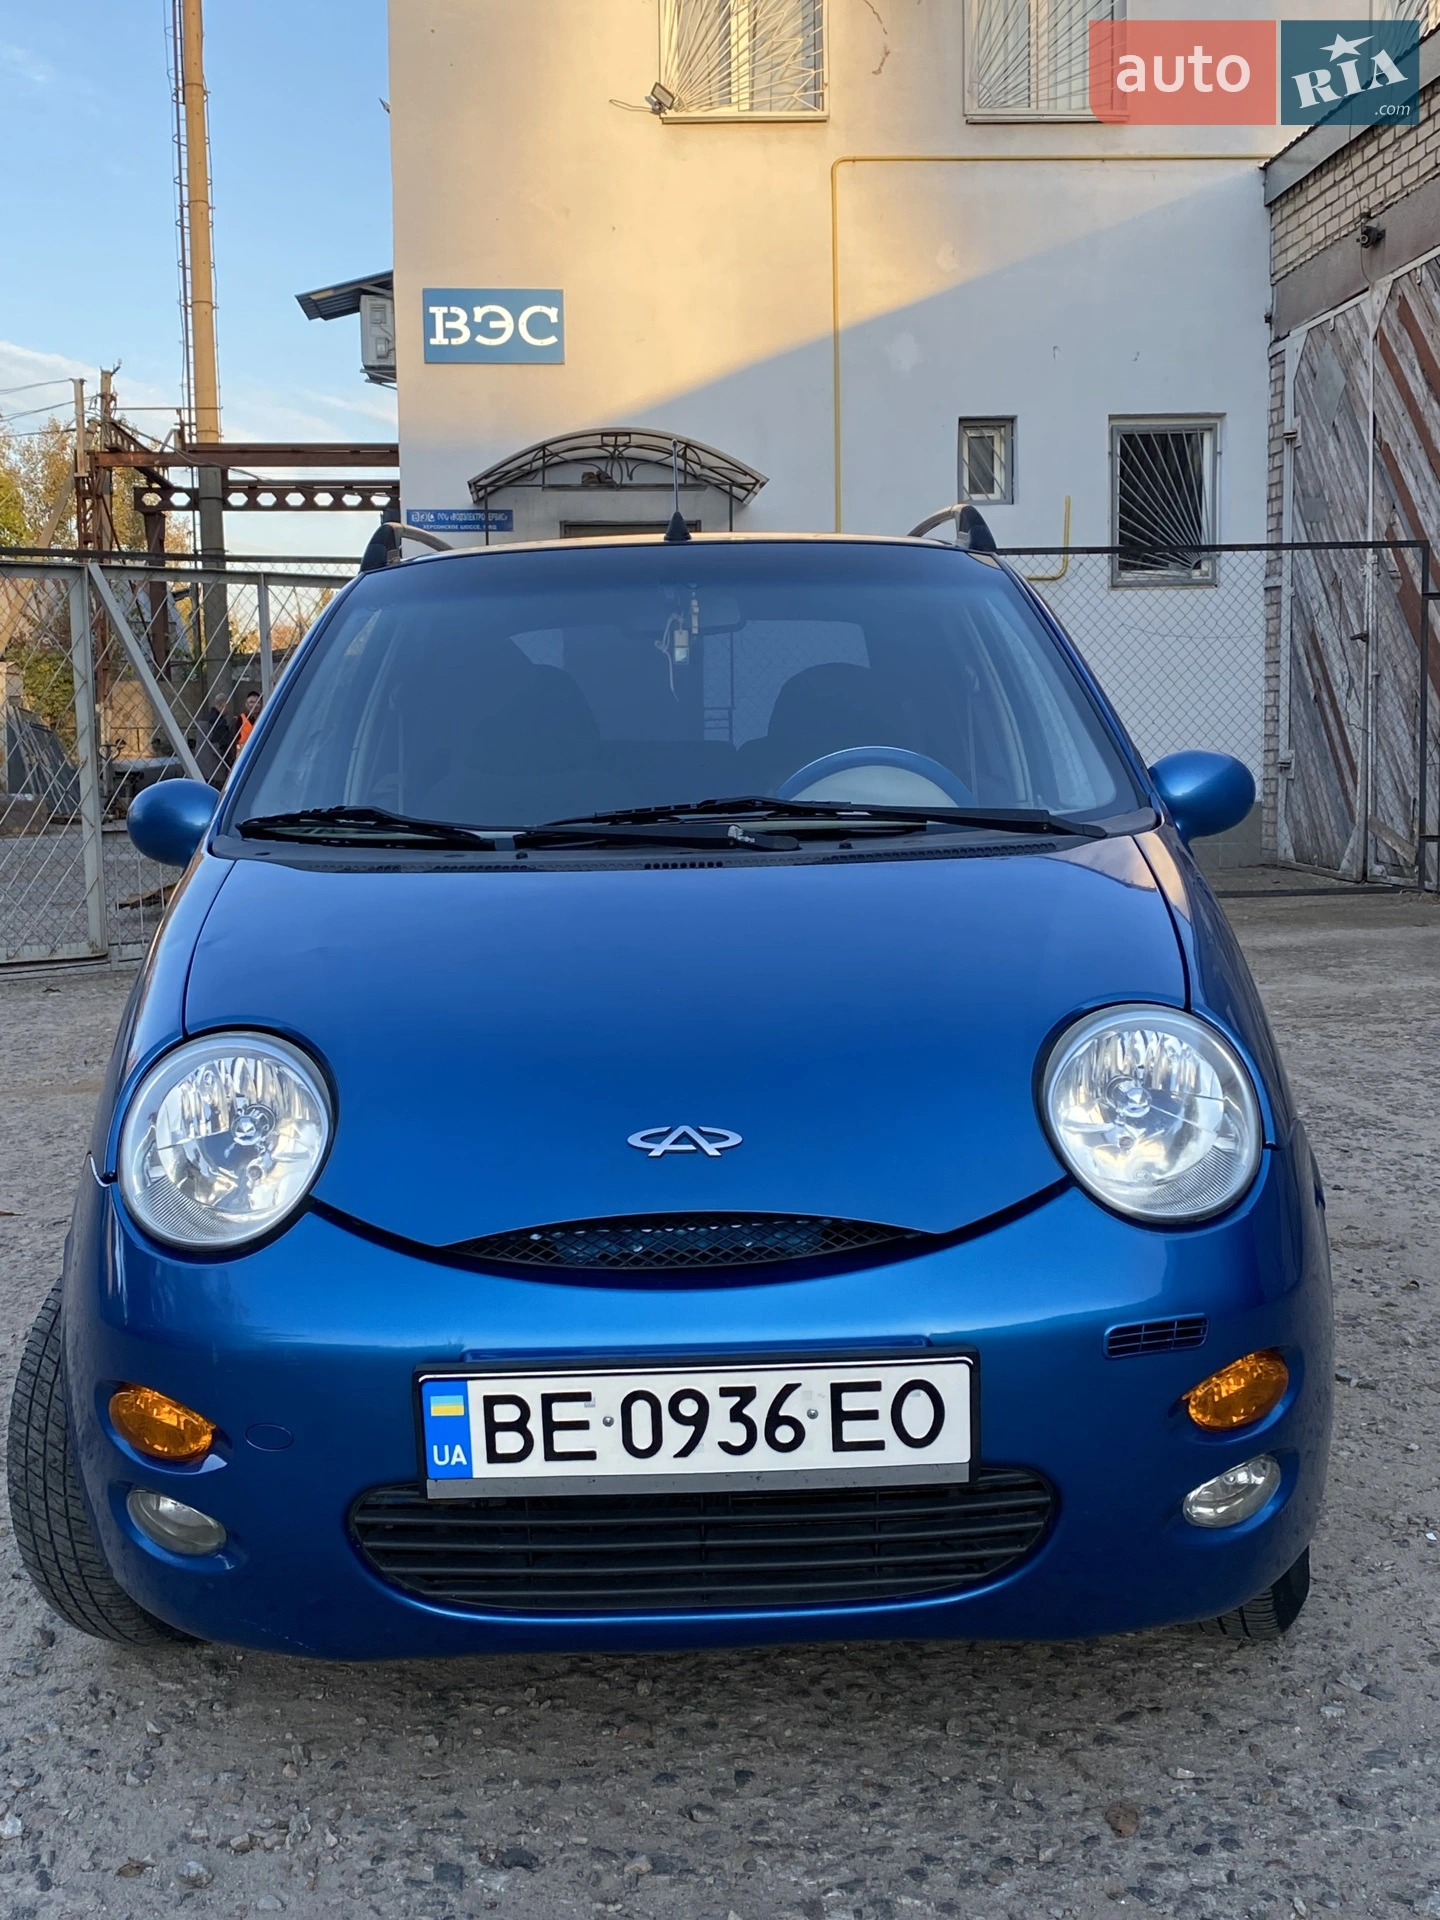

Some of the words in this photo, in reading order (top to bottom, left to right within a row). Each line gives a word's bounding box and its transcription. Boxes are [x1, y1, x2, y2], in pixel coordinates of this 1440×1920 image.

[429, 304, 559, 347] ВЭС
[482, 1391, 598, 1465] BE
[620, 1382, 806, 1459] 0936
[829, 1378, 946, 1453] EO
[432, 1444, 468, 1466] UA
